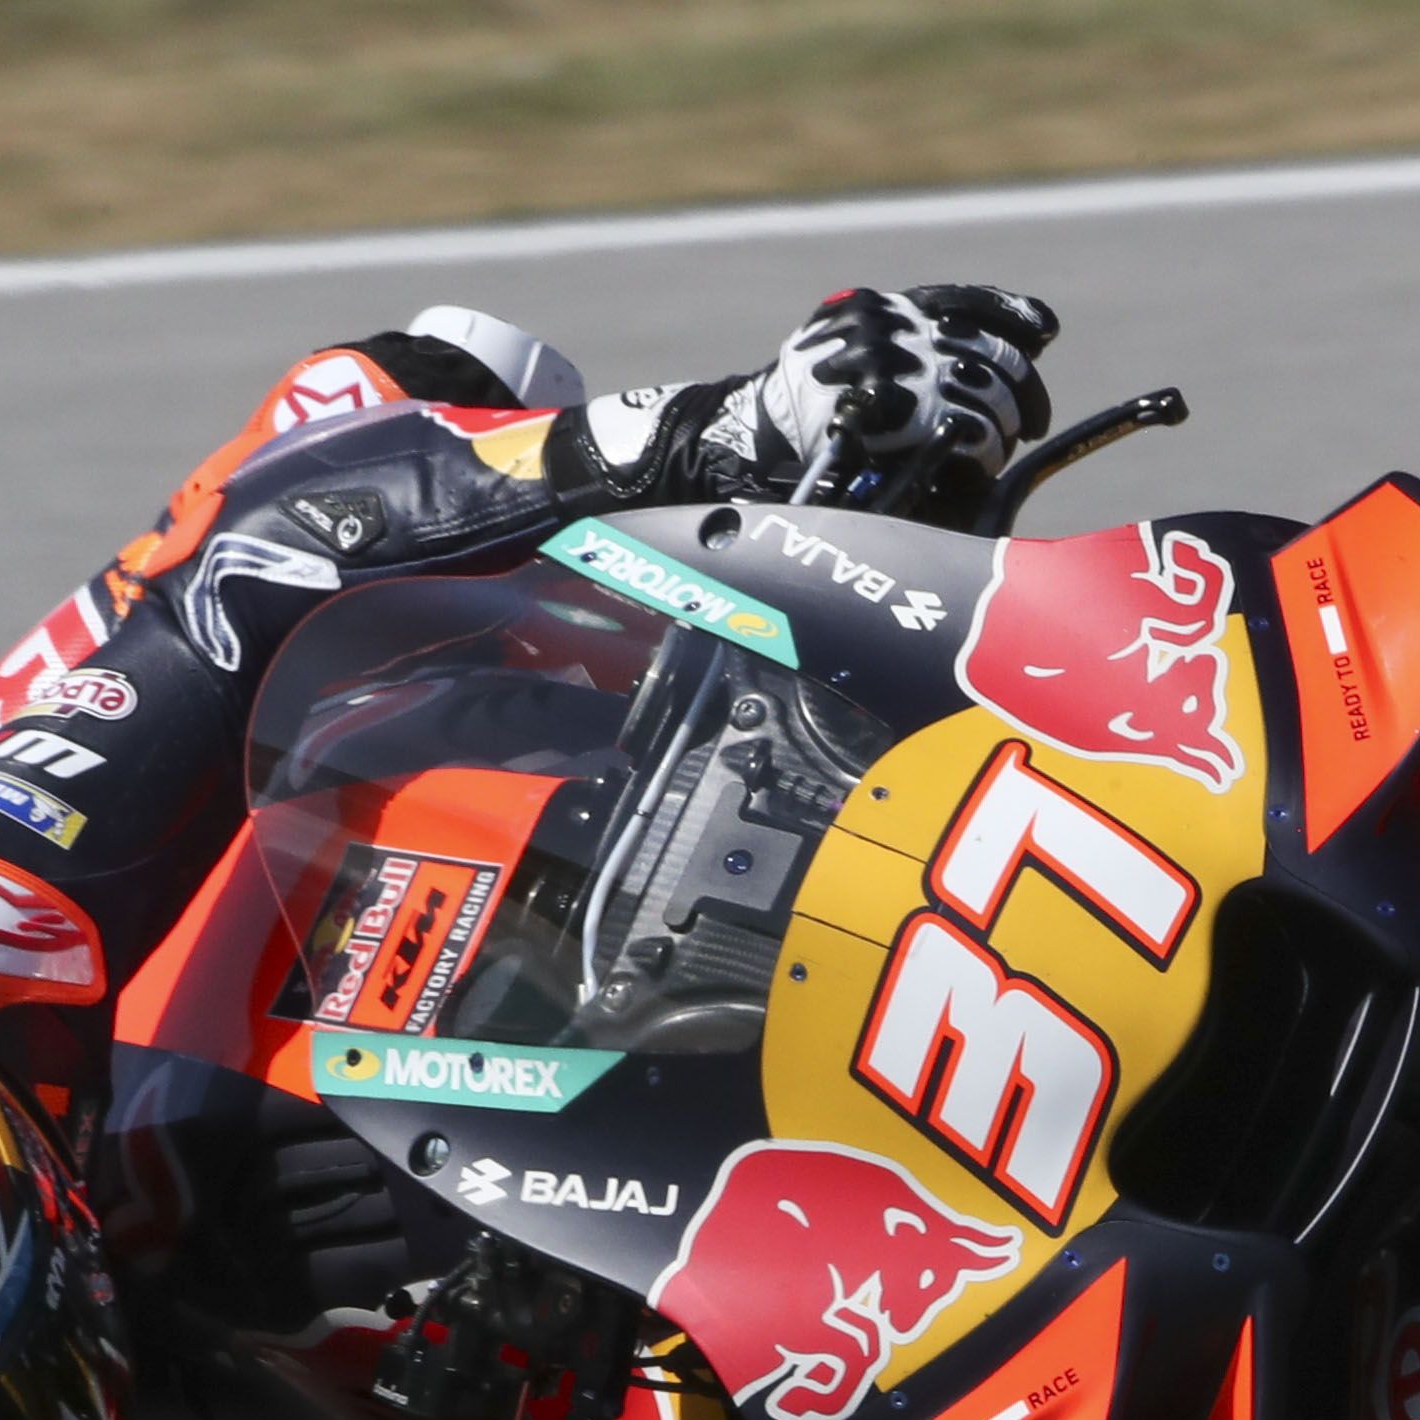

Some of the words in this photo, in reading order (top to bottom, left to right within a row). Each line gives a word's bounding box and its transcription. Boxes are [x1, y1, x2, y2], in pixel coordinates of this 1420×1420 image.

[567, 529, 736, 624] MOTOREX
[749, 513, 896, 603] BAJAJ
[1307, 557, 1334, 605] RACE
[1334, 655, 1353, 680] TO
[1340, 684, 1371, 741] READY
[314, 938, 381, 1022] Red
[354, 857, 419, 939] Bull
[380, 887, 447, 1011] KTM
[405, 947, 459, 1032] FACTORY
[449, 871, 497, 942] RACING
[854, 740, 1196, 1226] 37
[384, 1048, 563, 1098] MOTOREX
[520, 1170, 679, 1216] BAJAJ
[1027, 1367, 1080, 1409] RACE
